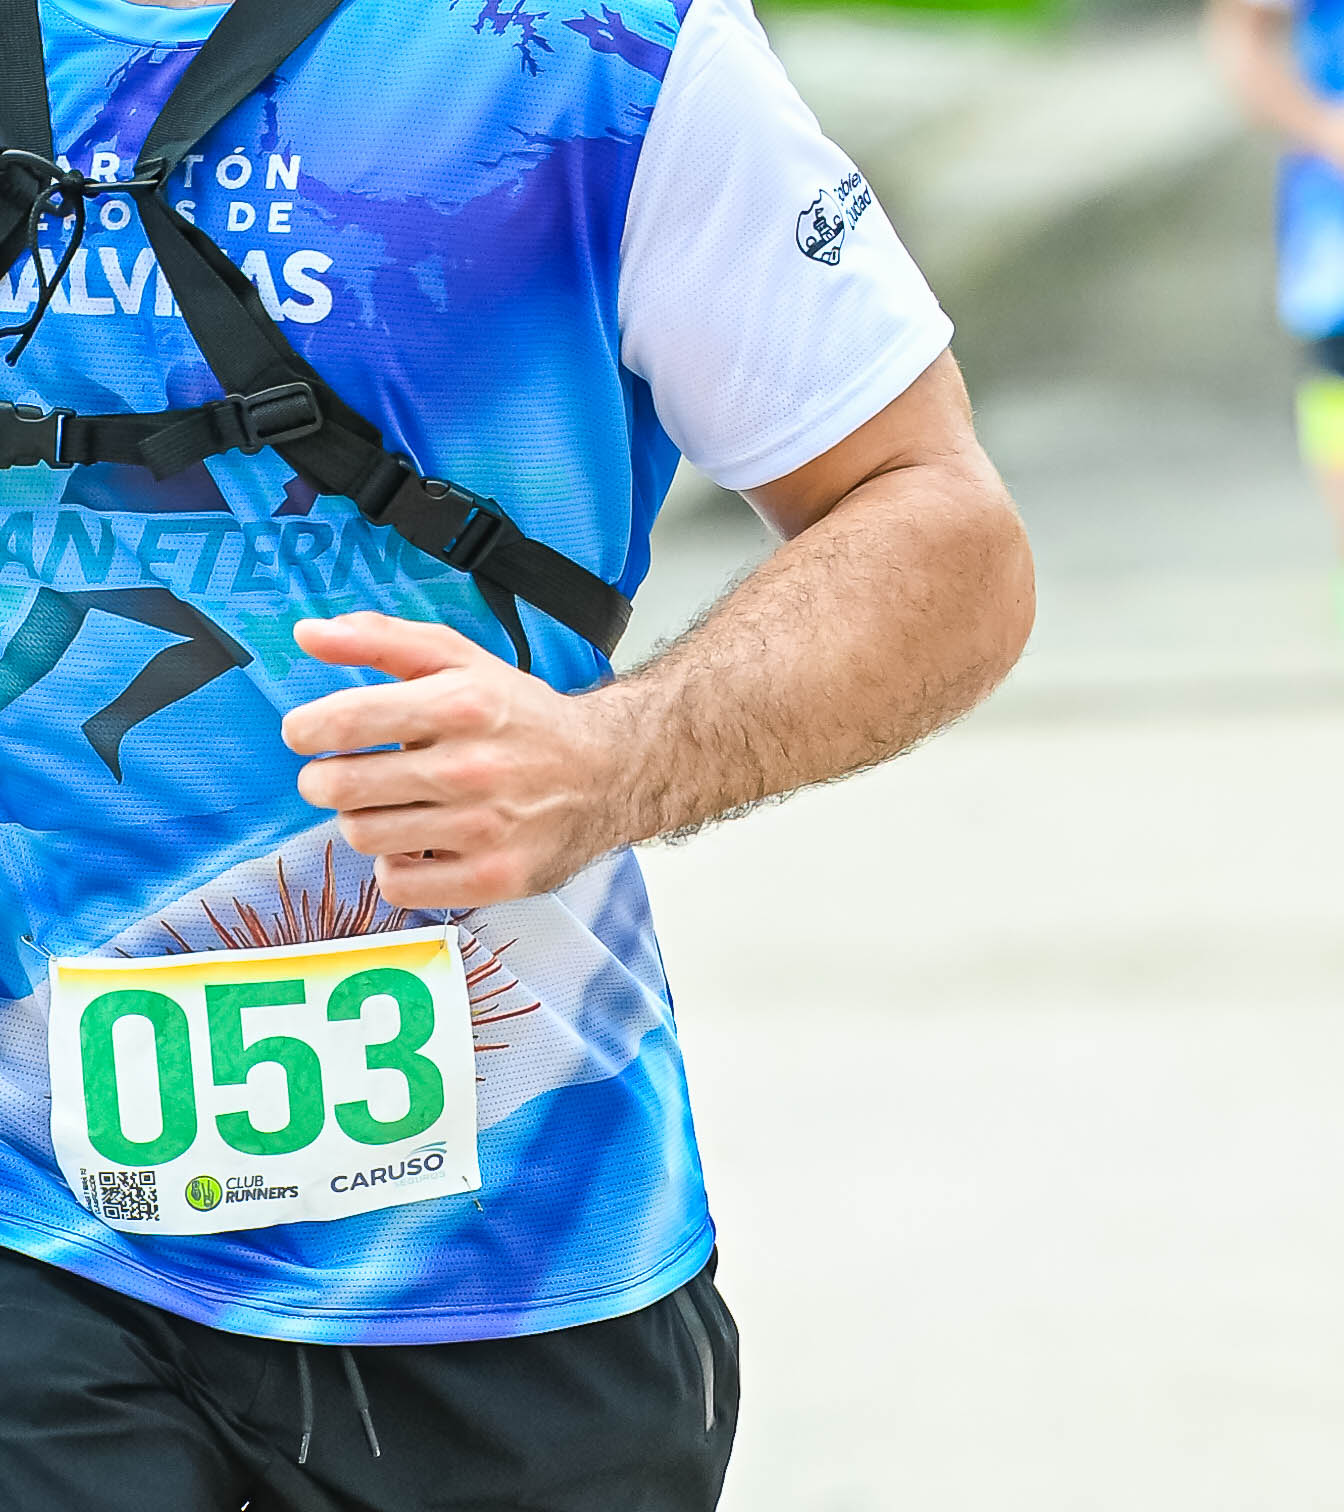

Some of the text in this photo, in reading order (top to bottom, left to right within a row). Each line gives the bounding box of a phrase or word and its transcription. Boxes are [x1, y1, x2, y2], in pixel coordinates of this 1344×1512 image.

[226, 200, 295, 234] DE
[79, 967, 446, 1168] 053
[225, 1174, 264, 1190] CLUB
[330, 1153, 444, 1193] CARUSO
[225, 1185, 299, 1204] RUNNER'S
